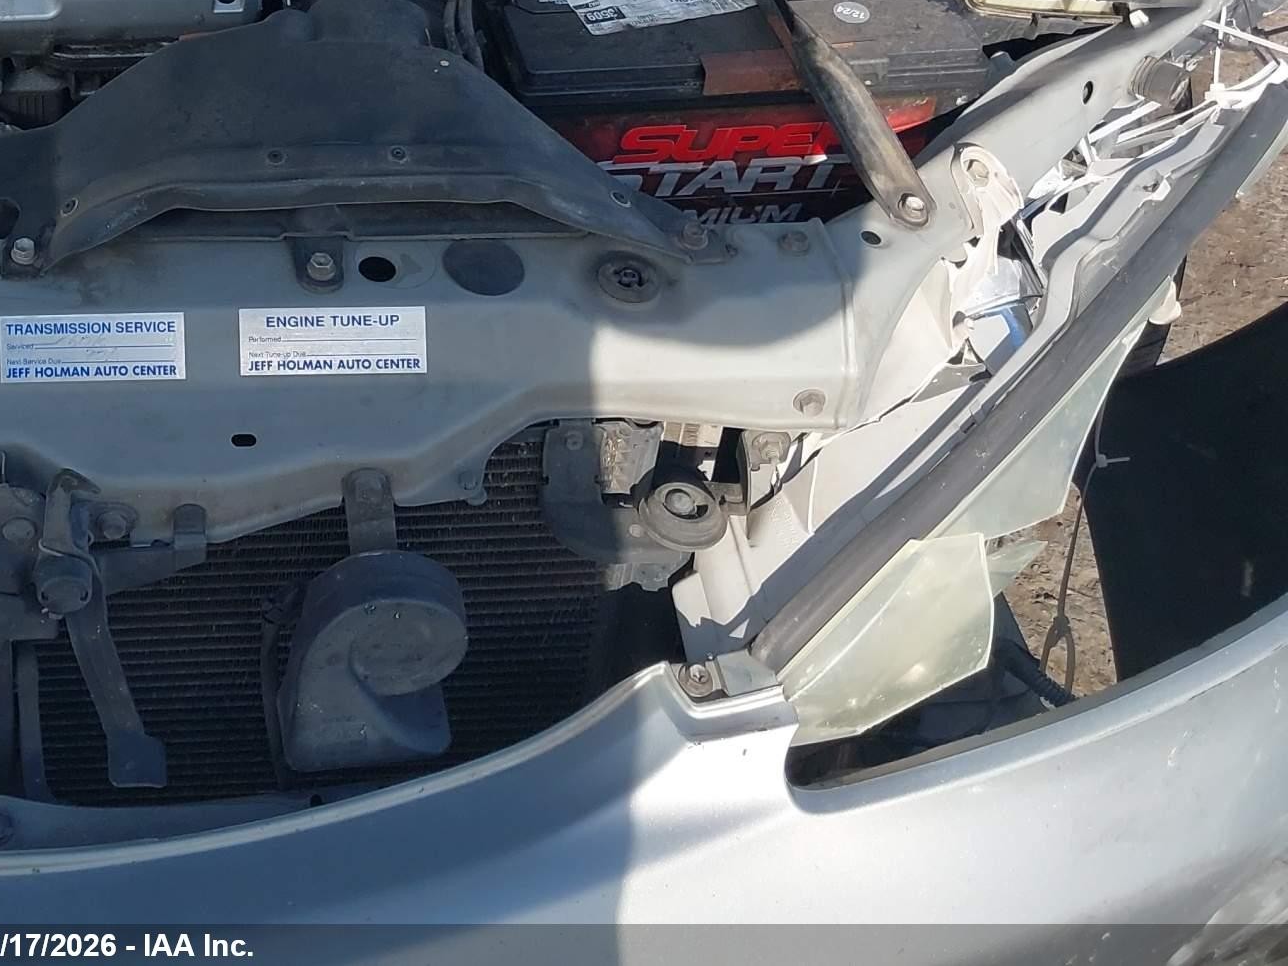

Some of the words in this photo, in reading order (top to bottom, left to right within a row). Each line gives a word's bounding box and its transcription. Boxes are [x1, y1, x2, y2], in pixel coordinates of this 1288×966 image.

[586, 8, 615, 22] 3509
[6, 321, 111, 335] TRANSMISSION
[115, 321, 176, 334] SERVICE
[266, 315, 325, 328] ENGINE
[330, 314, 400, 327] TUNE-UP
[6, 343, 35, 351] Serviced
[6, 367, 30, 378] JEFF
[35, 366, 90, 378] HOLMAN
[94, 365, 129, 377] AUTO
[132, 364, 177, 376] CENTER
[248, 360, 273, 371] JEFF
[277, 359, 333, 371] HOLMAN
[337, 358, 372, 370] AUTO
[376, 357, 420, 369] CENTER
